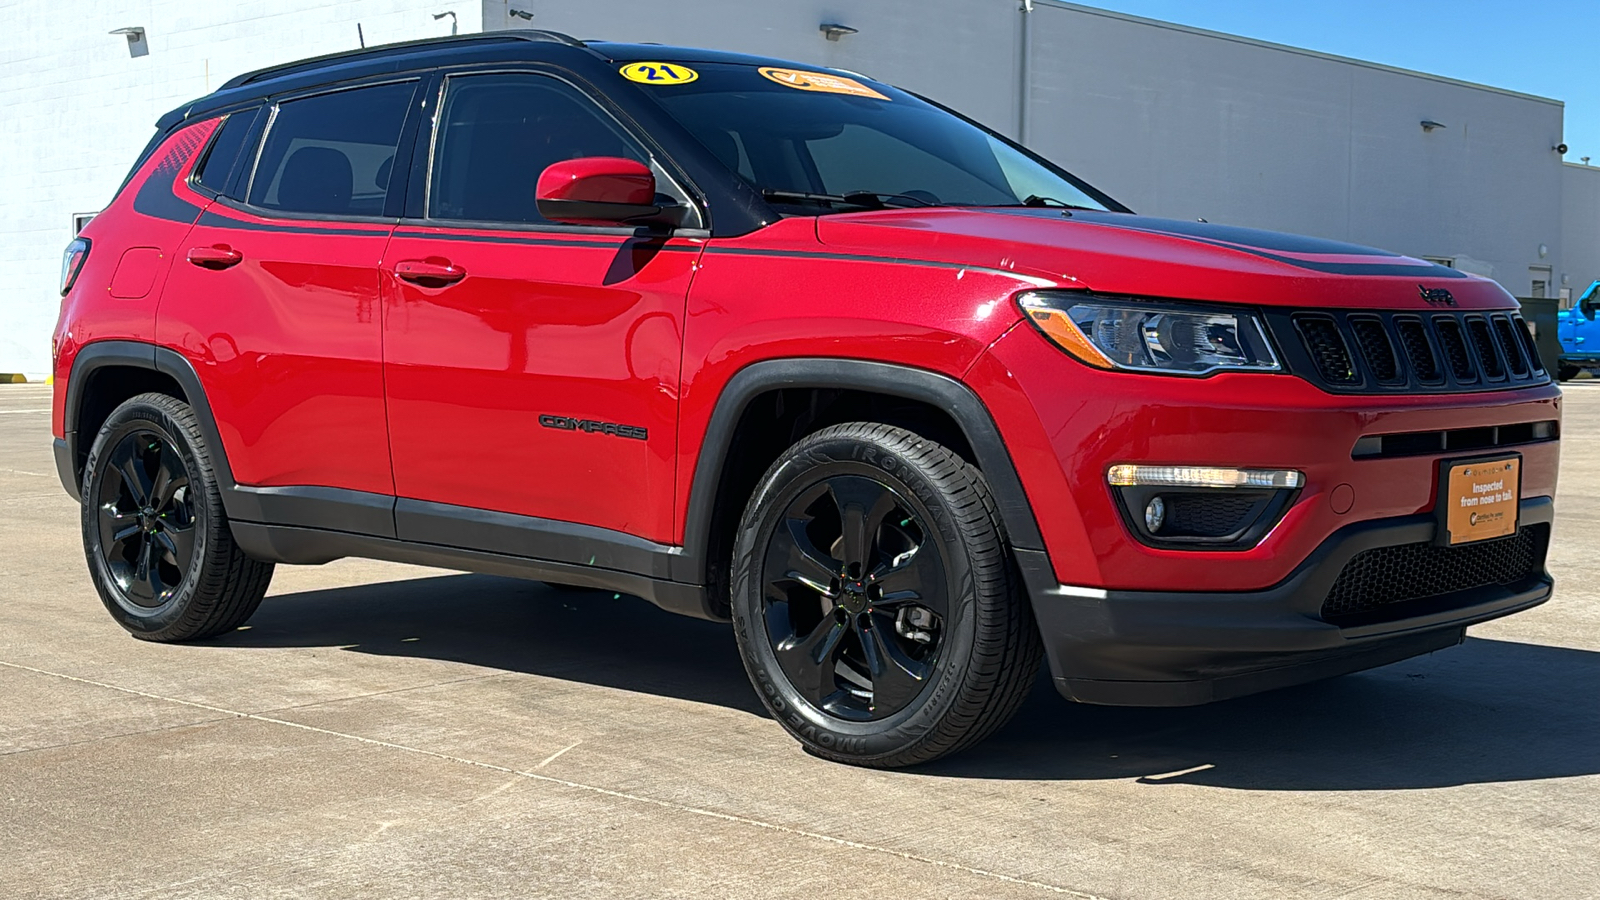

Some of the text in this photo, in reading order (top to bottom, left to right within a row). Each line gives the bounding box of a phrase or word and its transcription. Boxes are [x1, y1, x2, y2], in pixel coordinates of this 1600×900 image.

[638, 65, 679, 81] 21
[539, 414, 648, 441] COMPASS
[851, 444, 956, 542] IRONMAN
[1473, 480, 1503, 494] Inspected
[1461, 496, 1478, 507] from
[1479, 495, 1495, 505] nose
[1495, 493, 1502, 502] to
[757, 669, 786, 712] Gen
